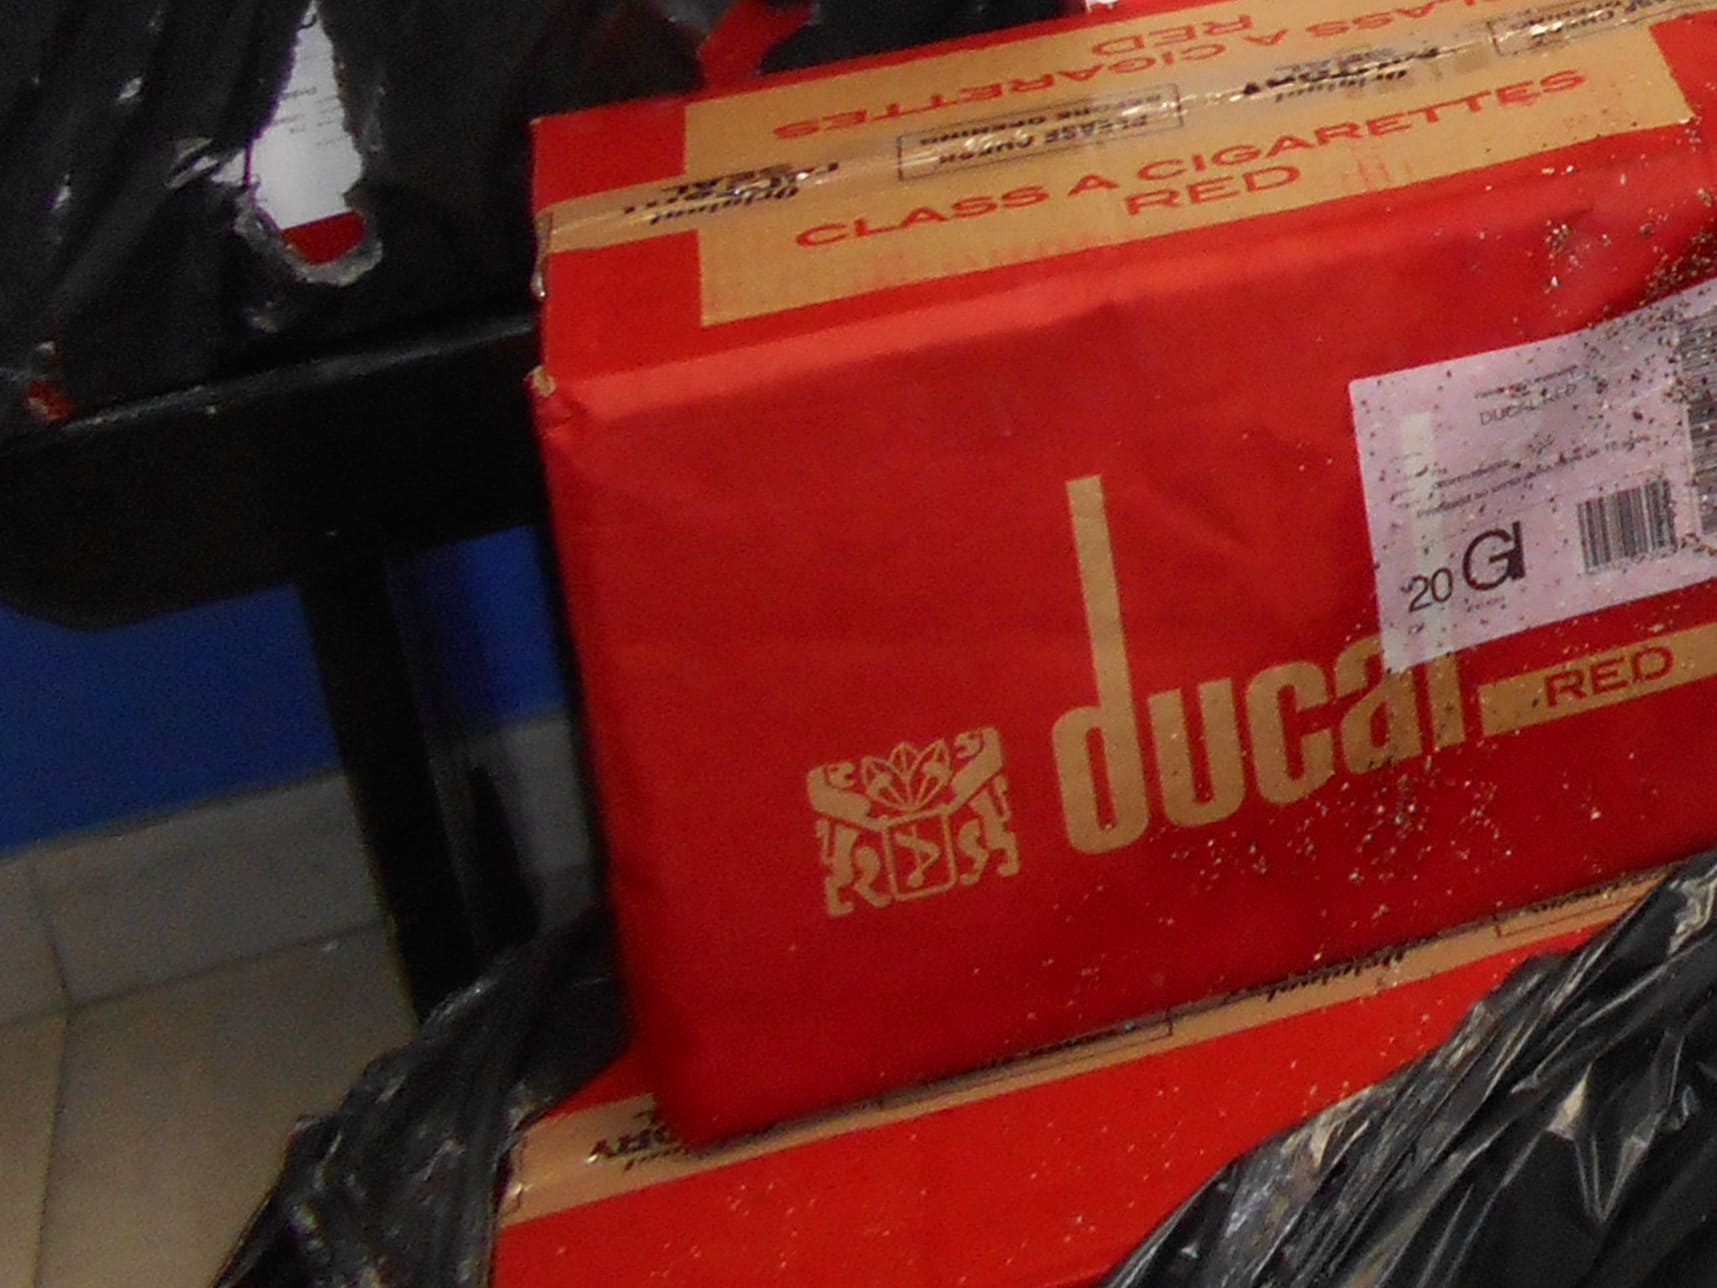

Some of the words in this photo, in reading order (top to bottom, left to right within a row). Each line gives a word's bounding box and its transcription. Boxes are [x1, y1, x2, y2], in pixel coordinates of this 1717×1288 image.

[1091, 14, 1253, 56] RED
[1245, 28, 1291, 48] A
[773, 44, 1226, 140] CIGARETTES
[796, 182, 1051, 250] CLASS
[1066, 174, 1120, 199] A
[1135, 68, 1587, 181] CIGARETTES
[1124, 165, 1301, 217] RED
[1405, 566, 1454, 612] 20
[1545, 644, 1674, 710] RED
